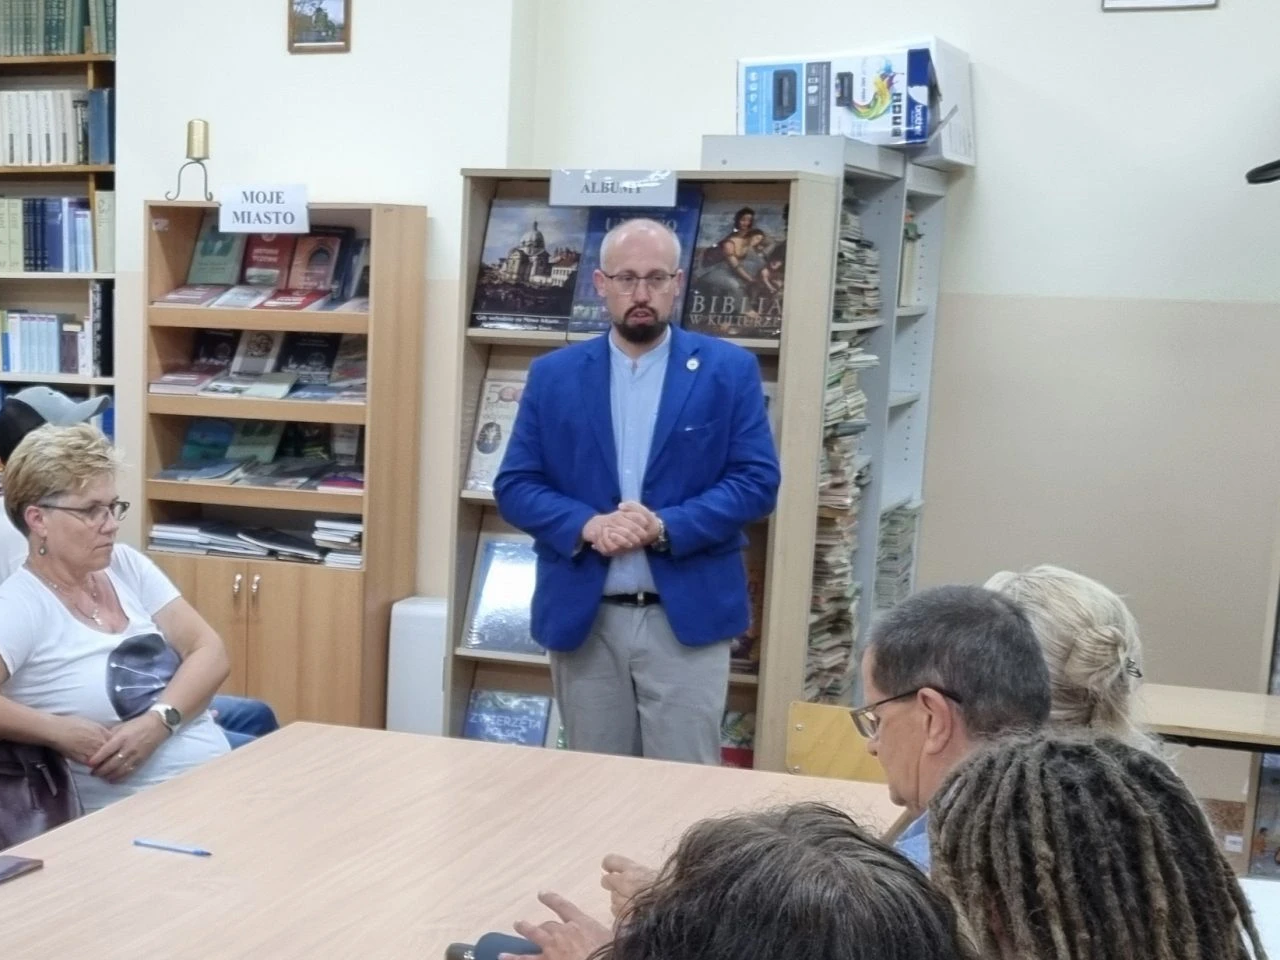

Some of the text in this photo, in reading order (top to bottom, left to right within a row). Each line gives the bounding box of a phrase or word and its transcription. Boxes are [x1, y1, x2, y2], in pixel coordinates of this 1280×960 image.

[241, 190, 286, 205] MOJE
[231, 211, 296, 225] MIASTO
[692, 295, 781, 315] BIBLIA
[470, 713, 541, 729] ZERZĘTA
